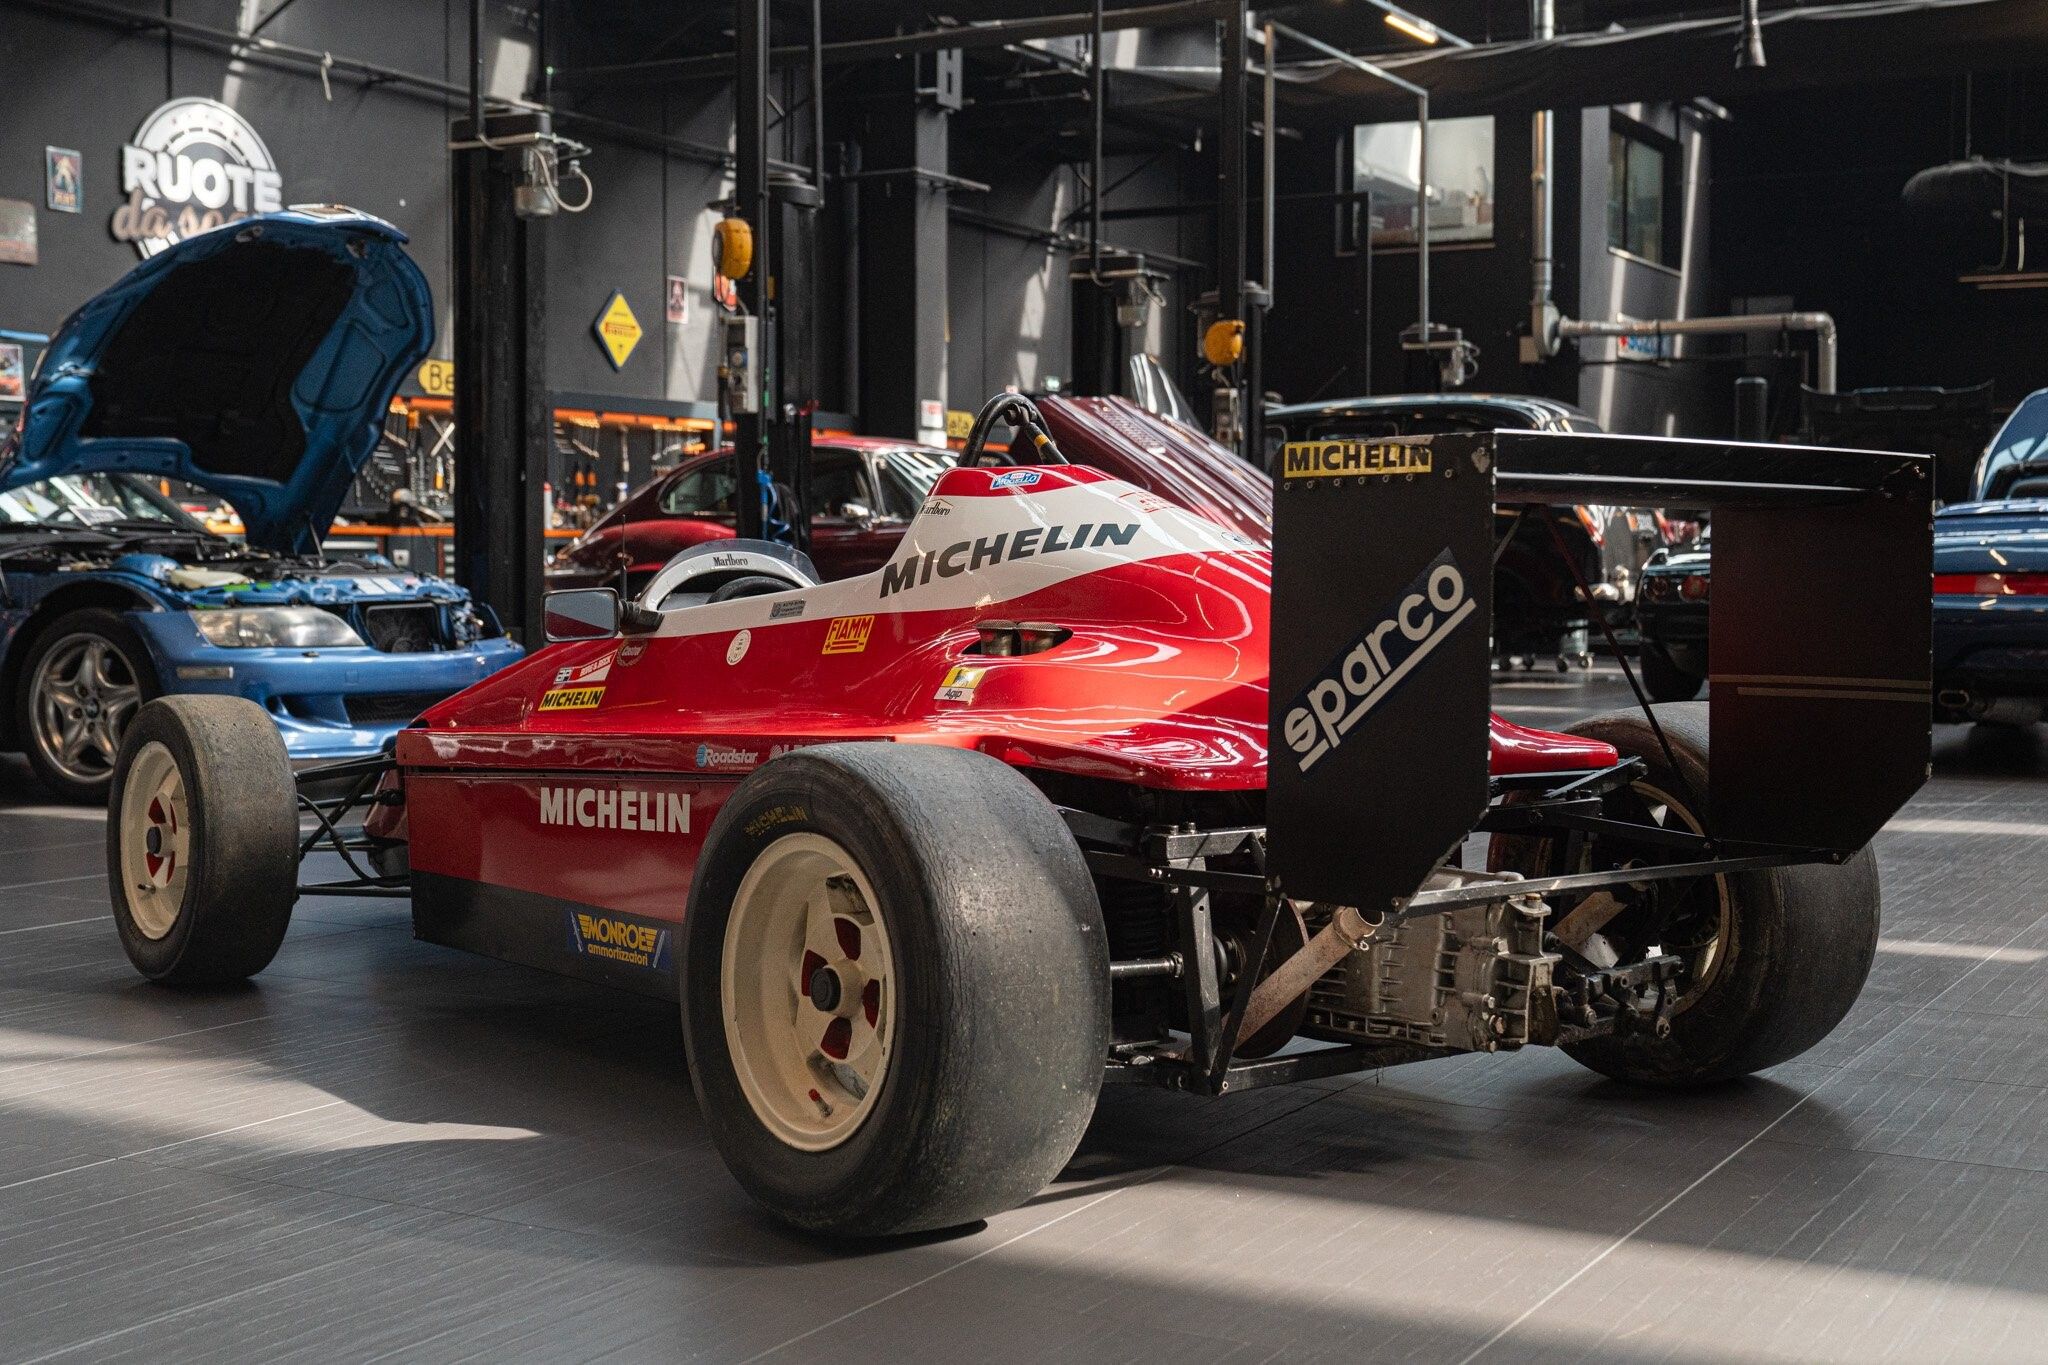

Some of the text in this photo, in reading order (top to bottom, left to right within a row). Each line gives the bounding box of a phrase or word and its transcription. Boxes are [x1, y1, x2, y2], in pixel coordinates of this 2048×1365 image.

[124, 144, 282, 213] RUOTE
[1288, 445, 1429, 471] MICHELIN
[713, 553, 749, 567] Marlboro
[879, 523, 1141, 599] MICHELIN
[828, 618, 870, 641] FIAMM
[1284, 564, 1464, 753] sparco
[541, 690, 603, 708] MICHELIN
[944, 688, 963, 700] Agip
[705, 748, 759, 767] Roadstar
[540, 786, 691, 834] MICHELIN
[579, 914, 656, 952] MONROE
[587, 943, 648, 967] ammortizzatori
